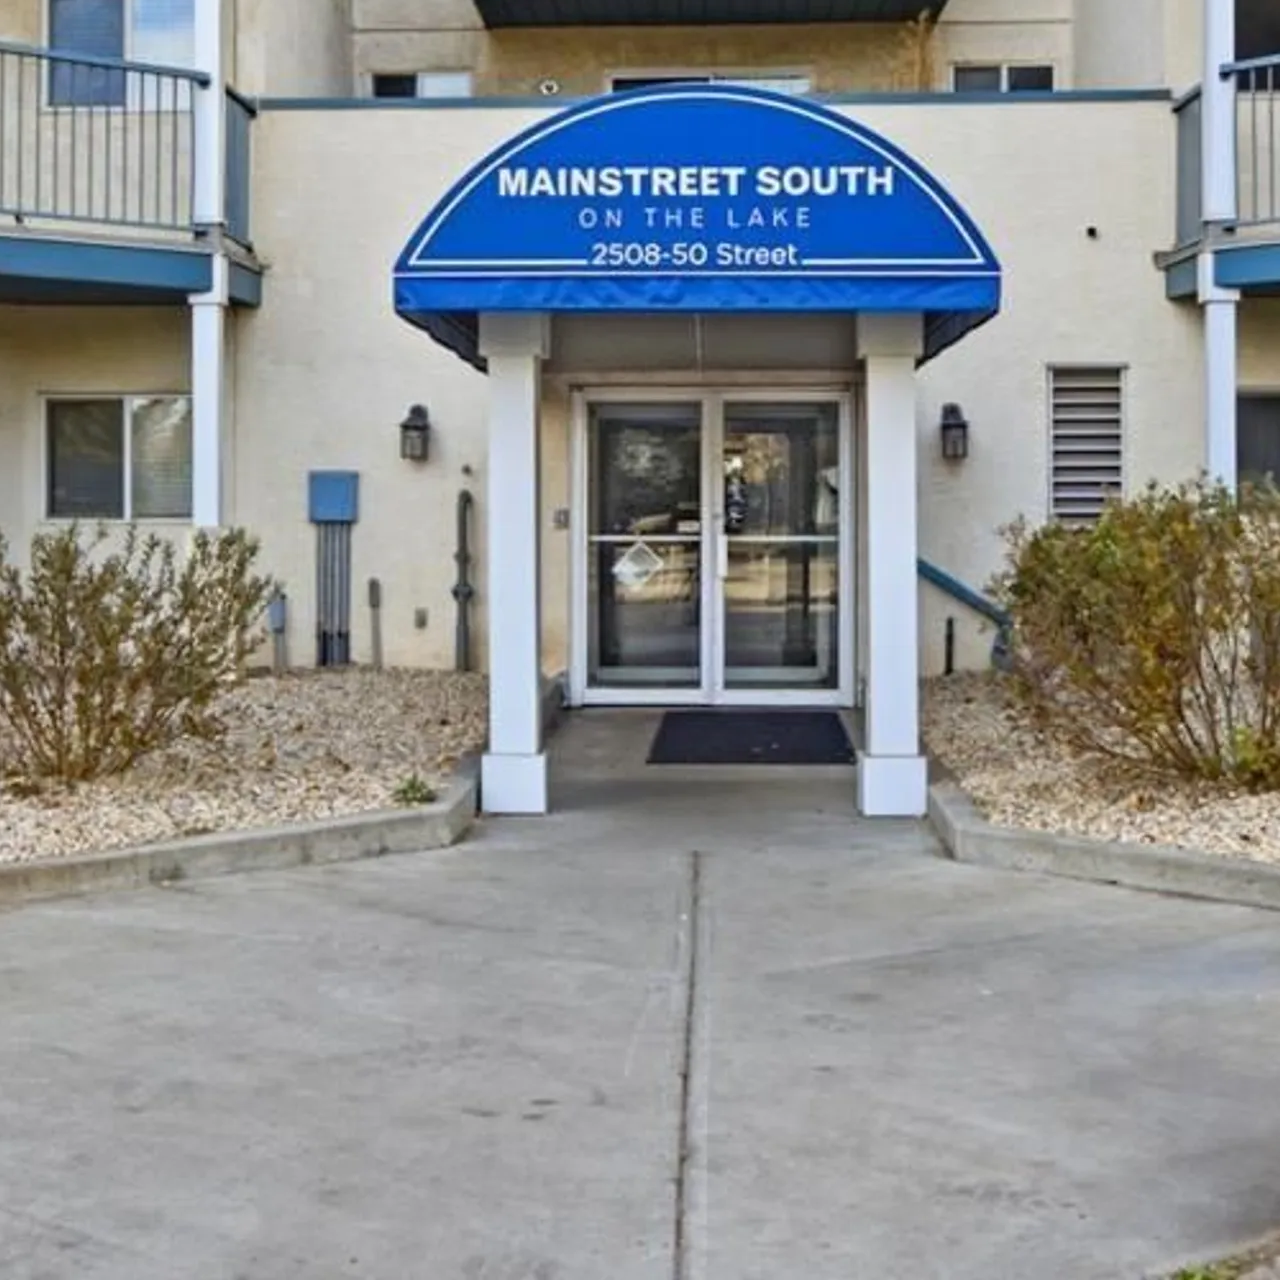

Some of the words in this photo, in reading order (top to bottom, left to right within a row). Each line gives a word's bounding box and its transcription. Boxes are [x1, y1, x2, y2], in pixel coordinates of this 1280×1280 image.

[497, 166, 746, 197] MAINSTREET
[755, 165, 895, 196] SOUTH
[578, 206, 623, 229] ON
[645, 206, 705, 228] THE
[727, 206, 812, 228] LAKE
[591, 243, 708, 267] 2508-50
[715, 243, 799, 267] Street
